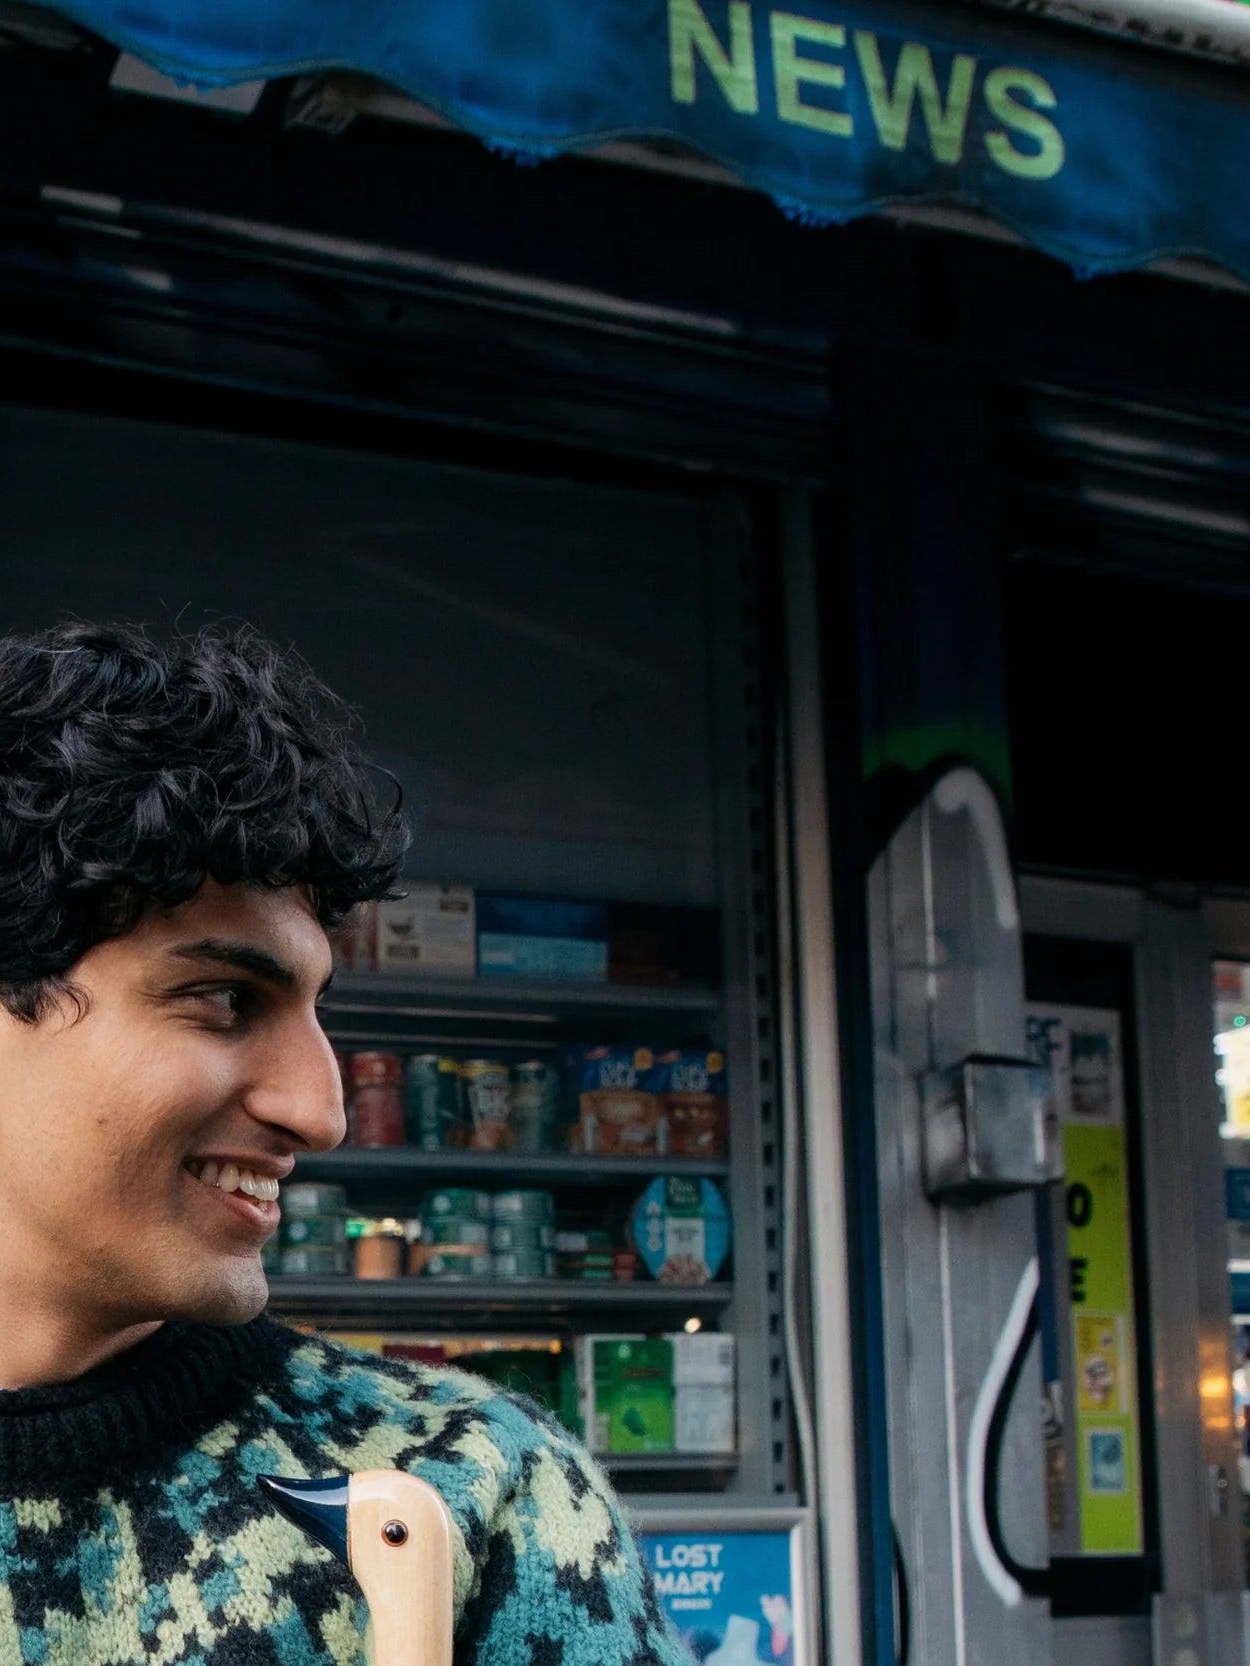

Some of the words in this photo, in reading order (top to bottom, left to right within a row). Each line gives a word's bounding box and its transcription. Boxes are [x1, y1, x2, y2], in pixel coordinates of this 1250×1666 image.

[667, 0, 1065, 179] NEWS
[655, 1543, 724, 1568] LOST
[654, 1570, 725, 1595] MARY
